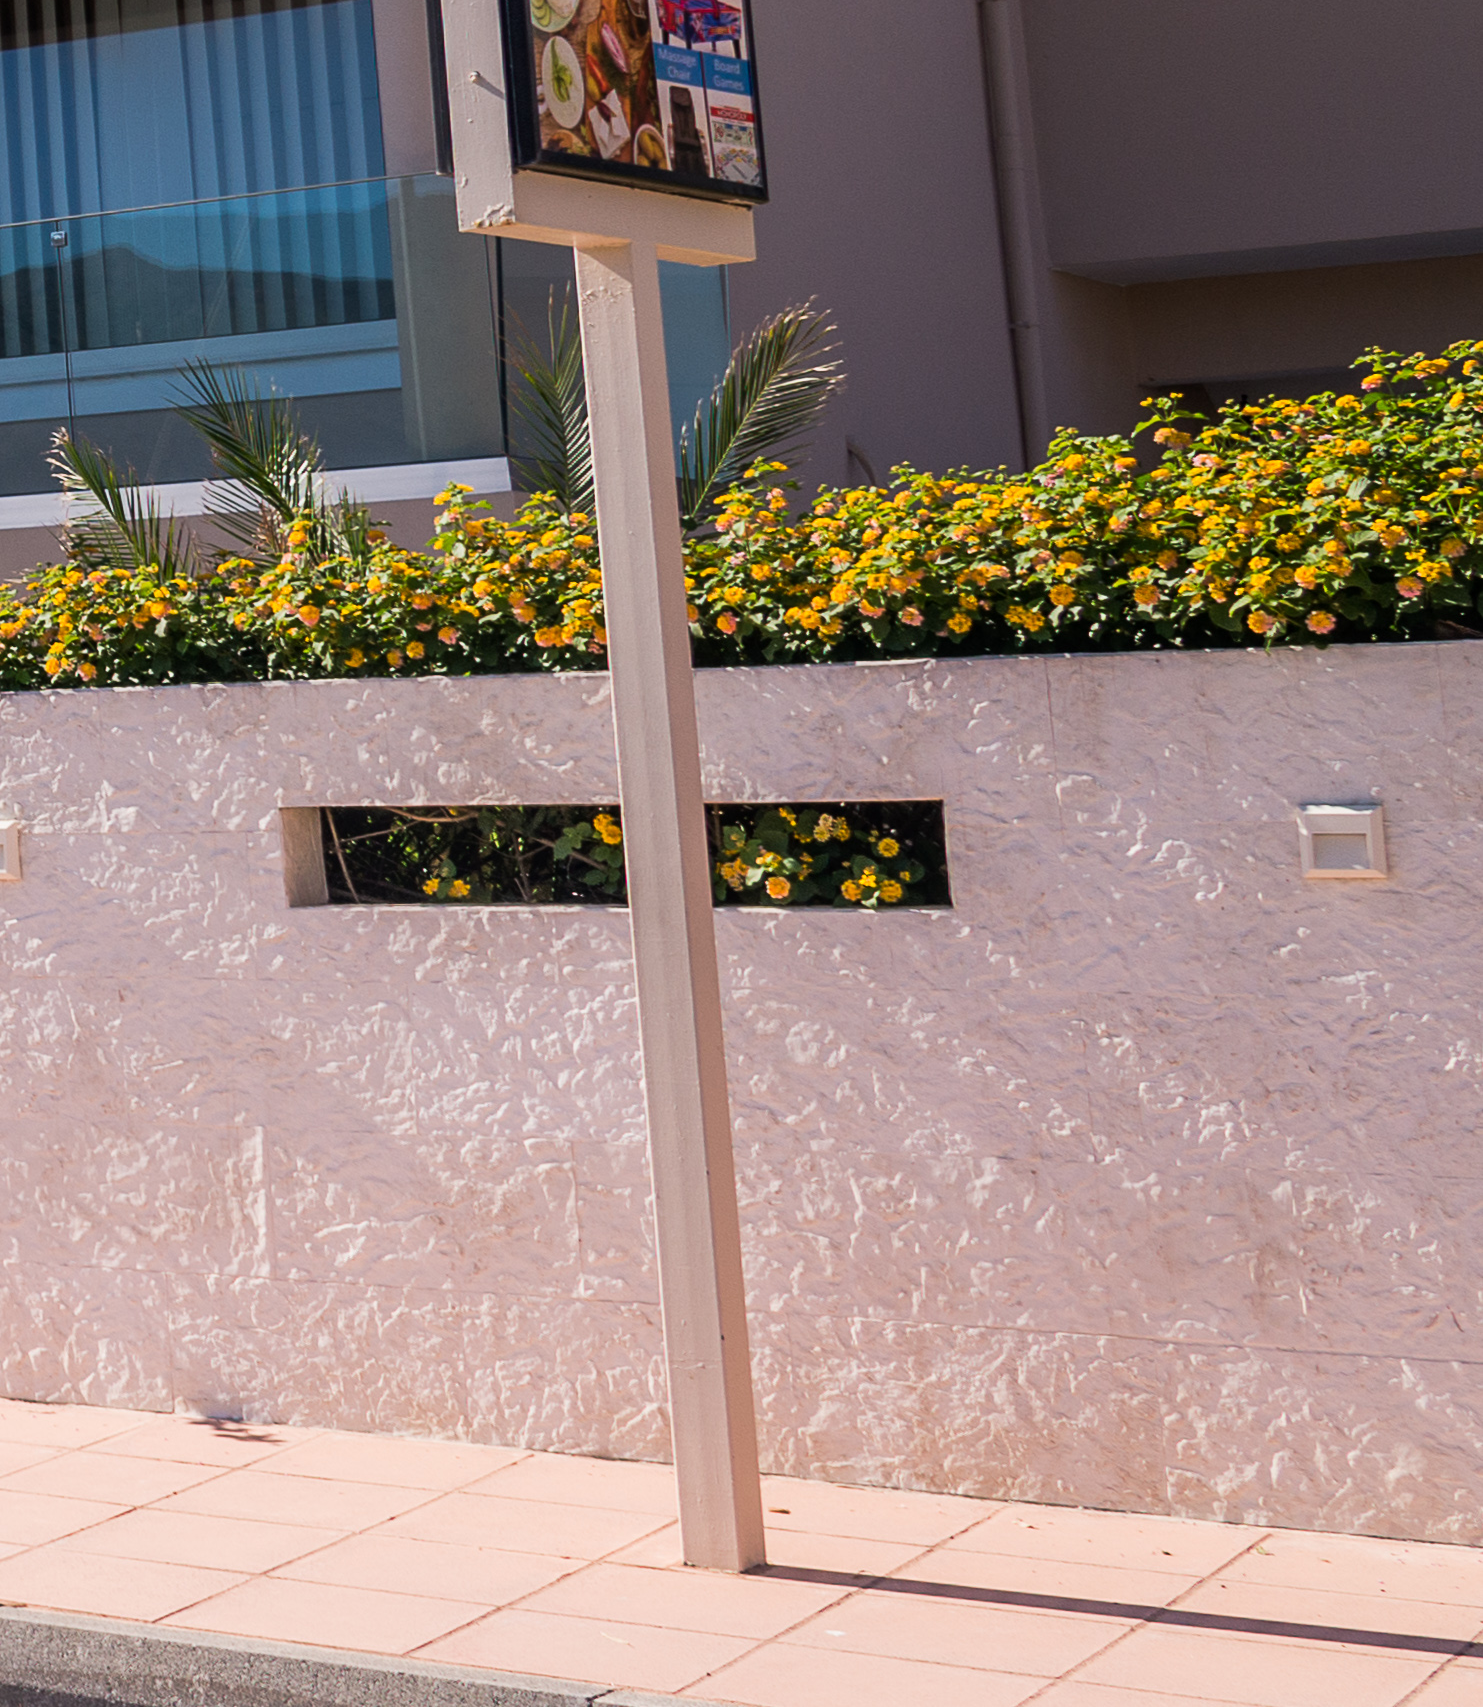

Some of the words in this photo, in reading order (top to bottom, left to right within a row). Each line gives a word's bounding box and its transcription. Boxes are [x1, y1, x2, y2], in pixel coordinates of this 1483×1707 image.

[658, 47, 697, 68] Massage
[667, 65, 691, 80] Chair
[713, 59, 740, 75] Board
[713, 75, 745, 91] Games
